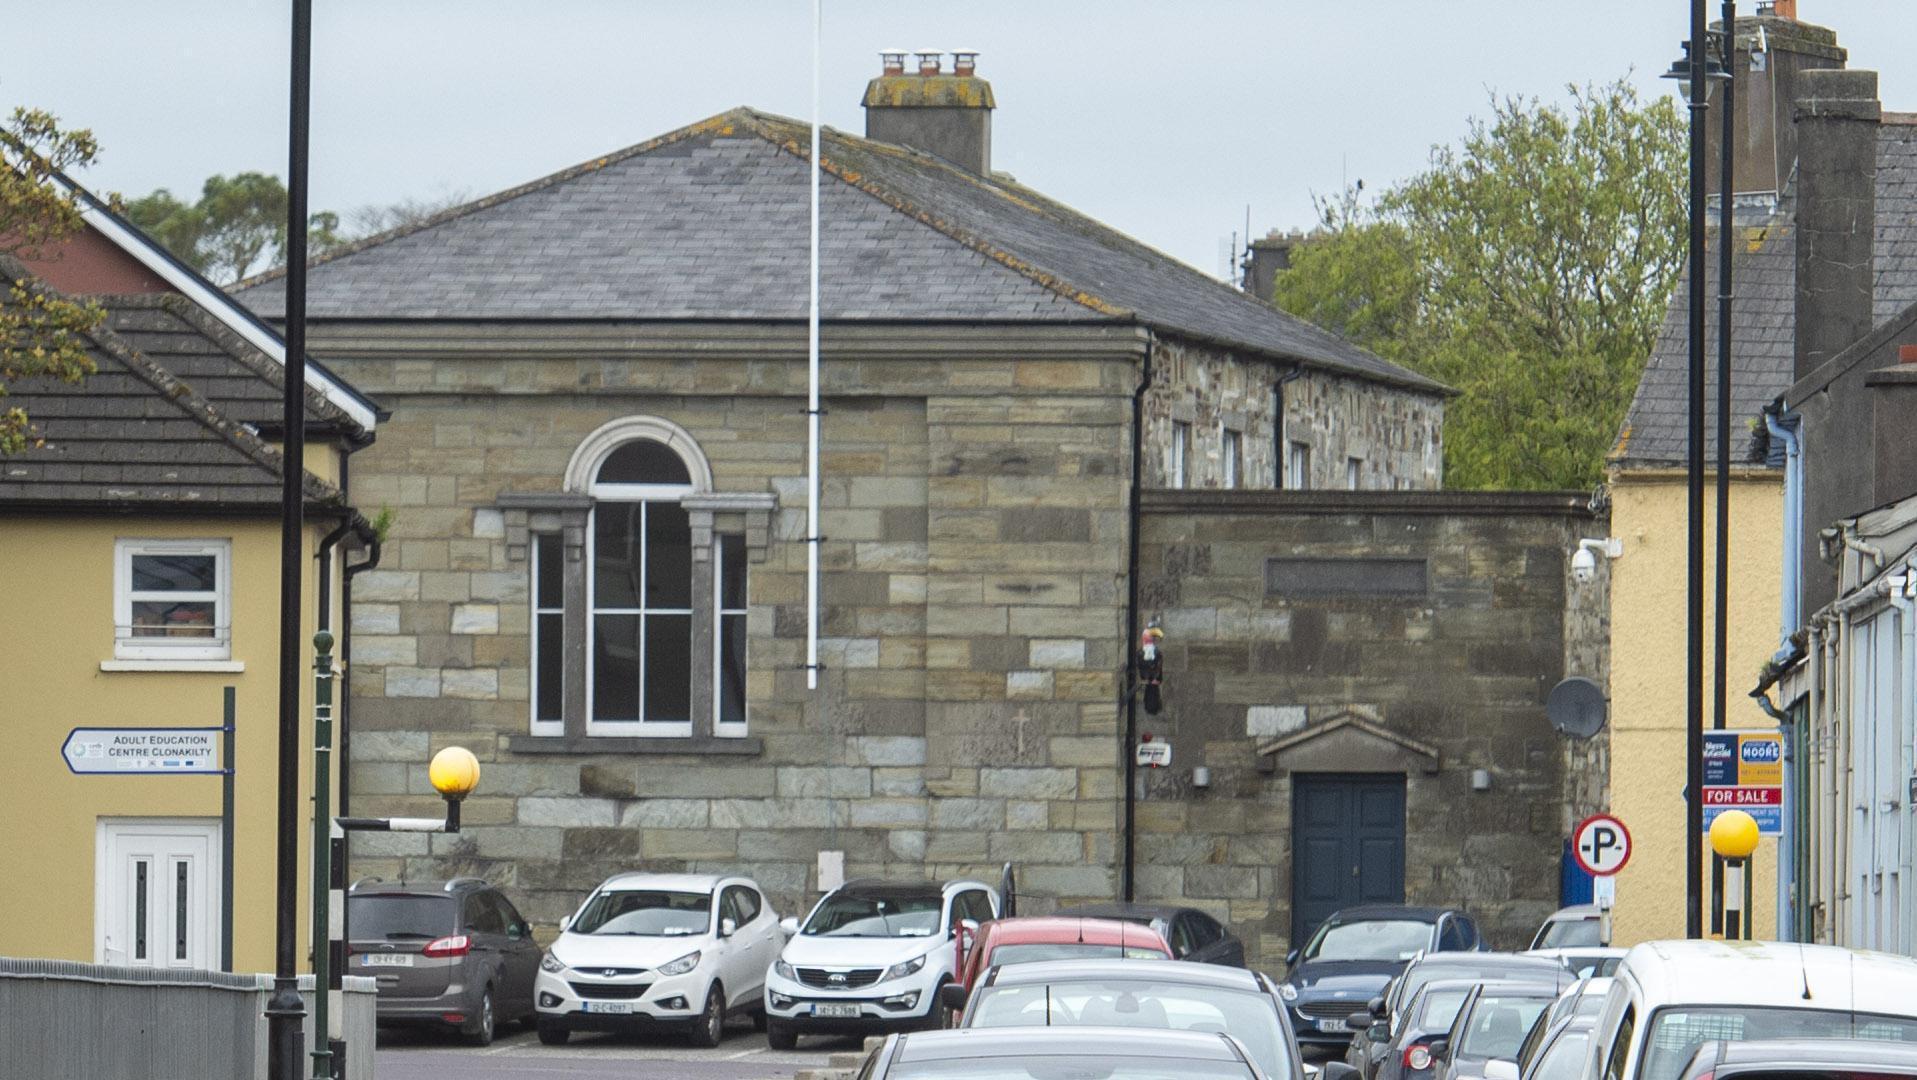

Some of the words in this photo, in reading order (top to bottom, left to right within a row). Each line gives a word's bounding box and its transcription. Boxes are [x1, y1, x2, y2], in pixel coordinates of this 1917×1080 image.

[113, 735, 146, 745] ADULT
[149, 735, 208, 745] EDUCATION
[108, 747, 149, 757] CENTRE
[151, 747, 212, 757] CLONAKILTY
[1743, 747, 1779, 758] MOORE
[1707, 790, 1733, 803] FOR
[1736, 790, 1769, 803] SALE
